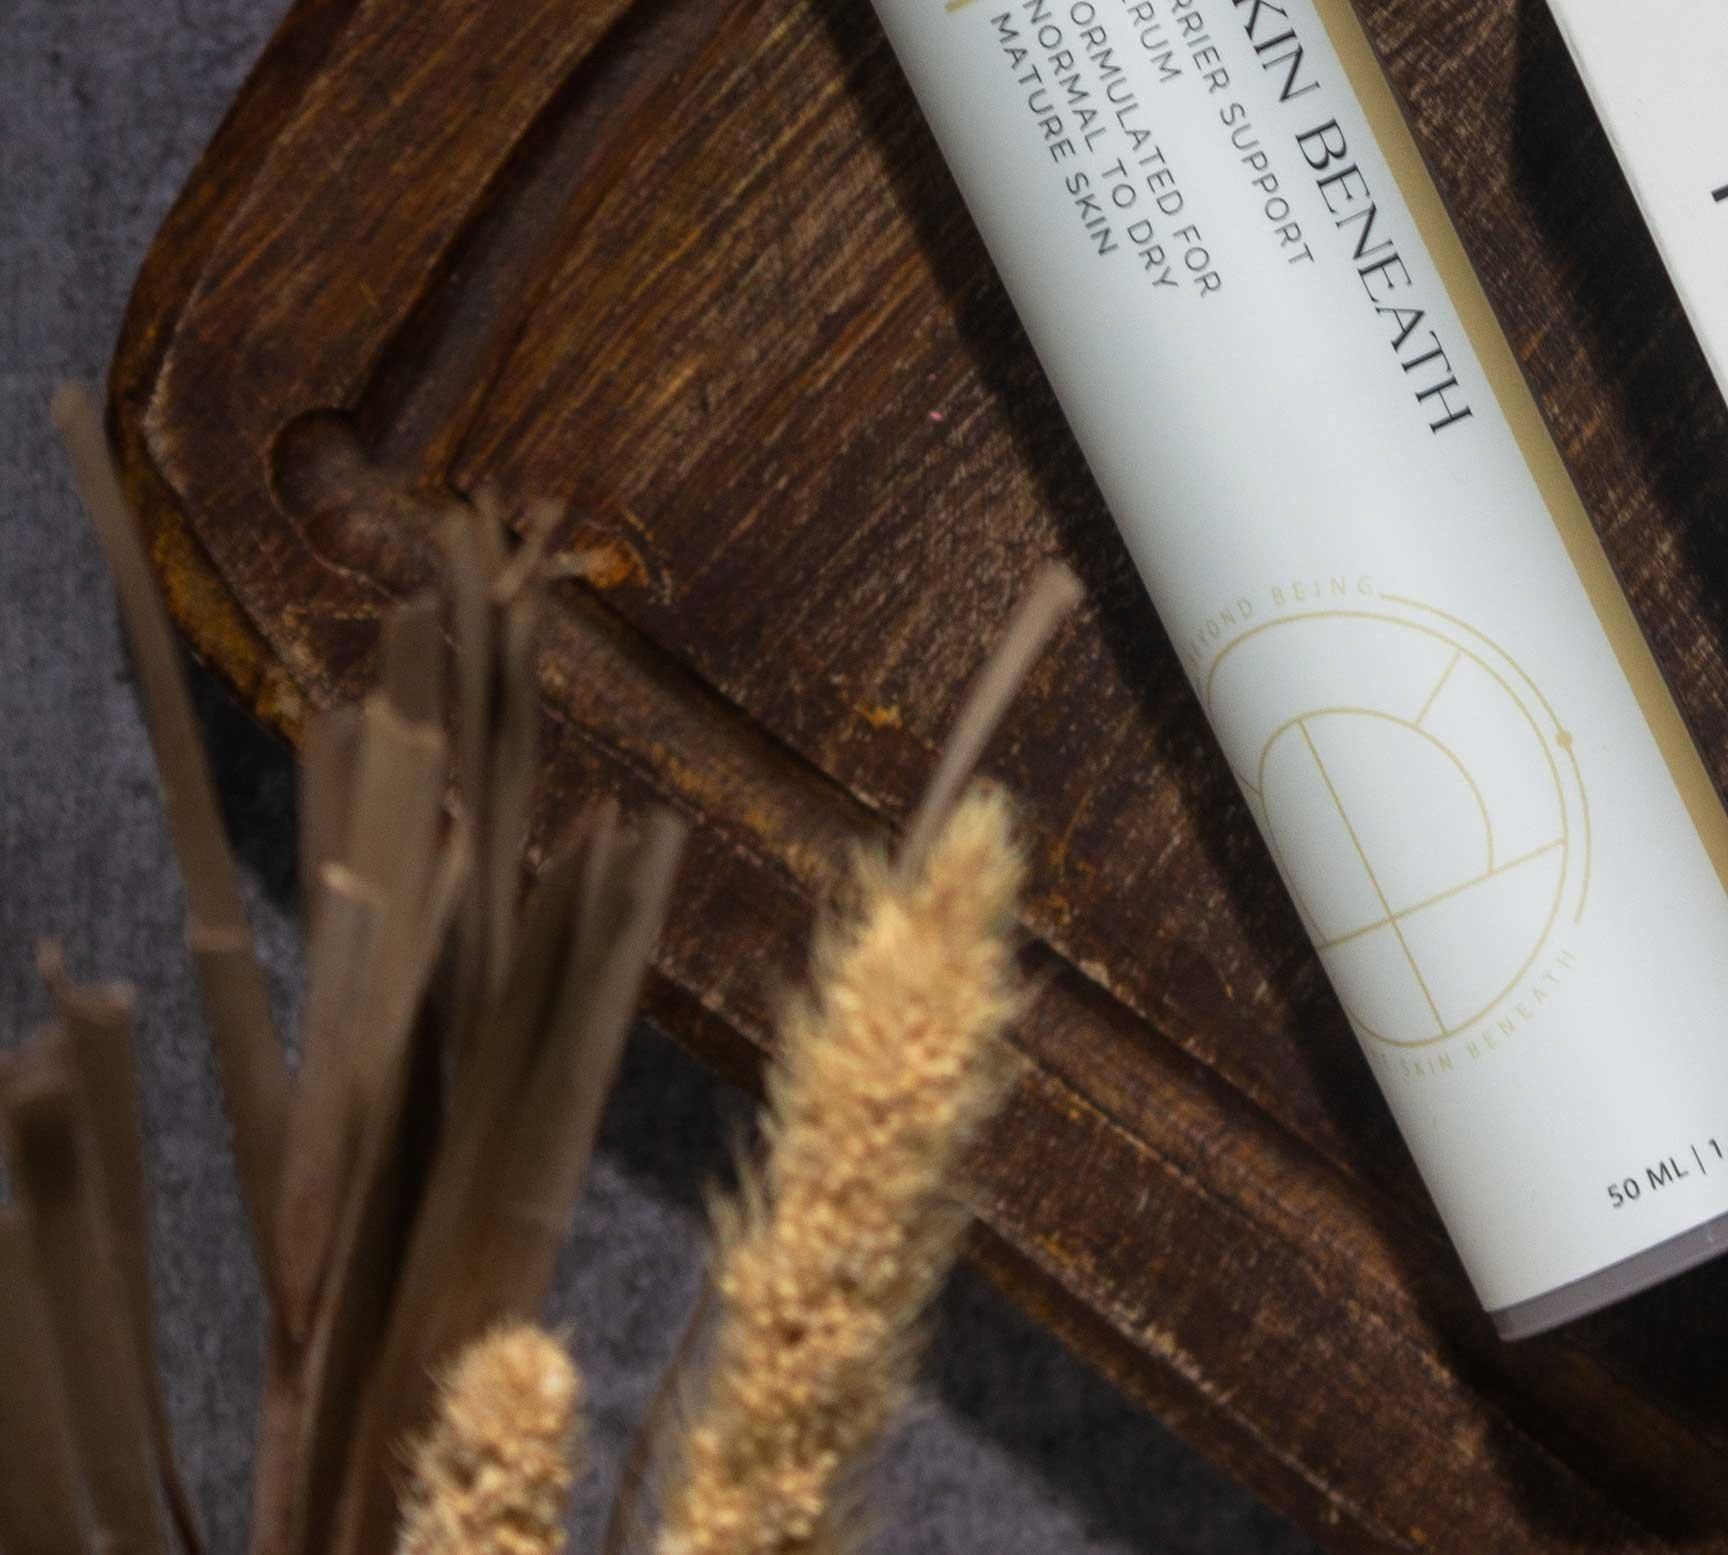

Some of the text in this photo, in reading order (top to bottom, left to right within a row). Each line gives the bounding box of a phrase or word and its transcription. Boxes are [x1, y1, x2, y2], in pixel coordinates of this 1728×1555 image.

[991, 13, 1118, 256] MATURE SKIN
[1220, 103, 1314, 263] SUPPORT
[1102, 158, 1136, 208] TO
[1127, 219, 1178, 286] DRY
[1173, 225, 1221, 297] FOR
[1296, 118, 1473, 433] BENEATH
[1608, 1178, 1640, 1207] 50
[1646, 1158, 1688, 1189] ML
